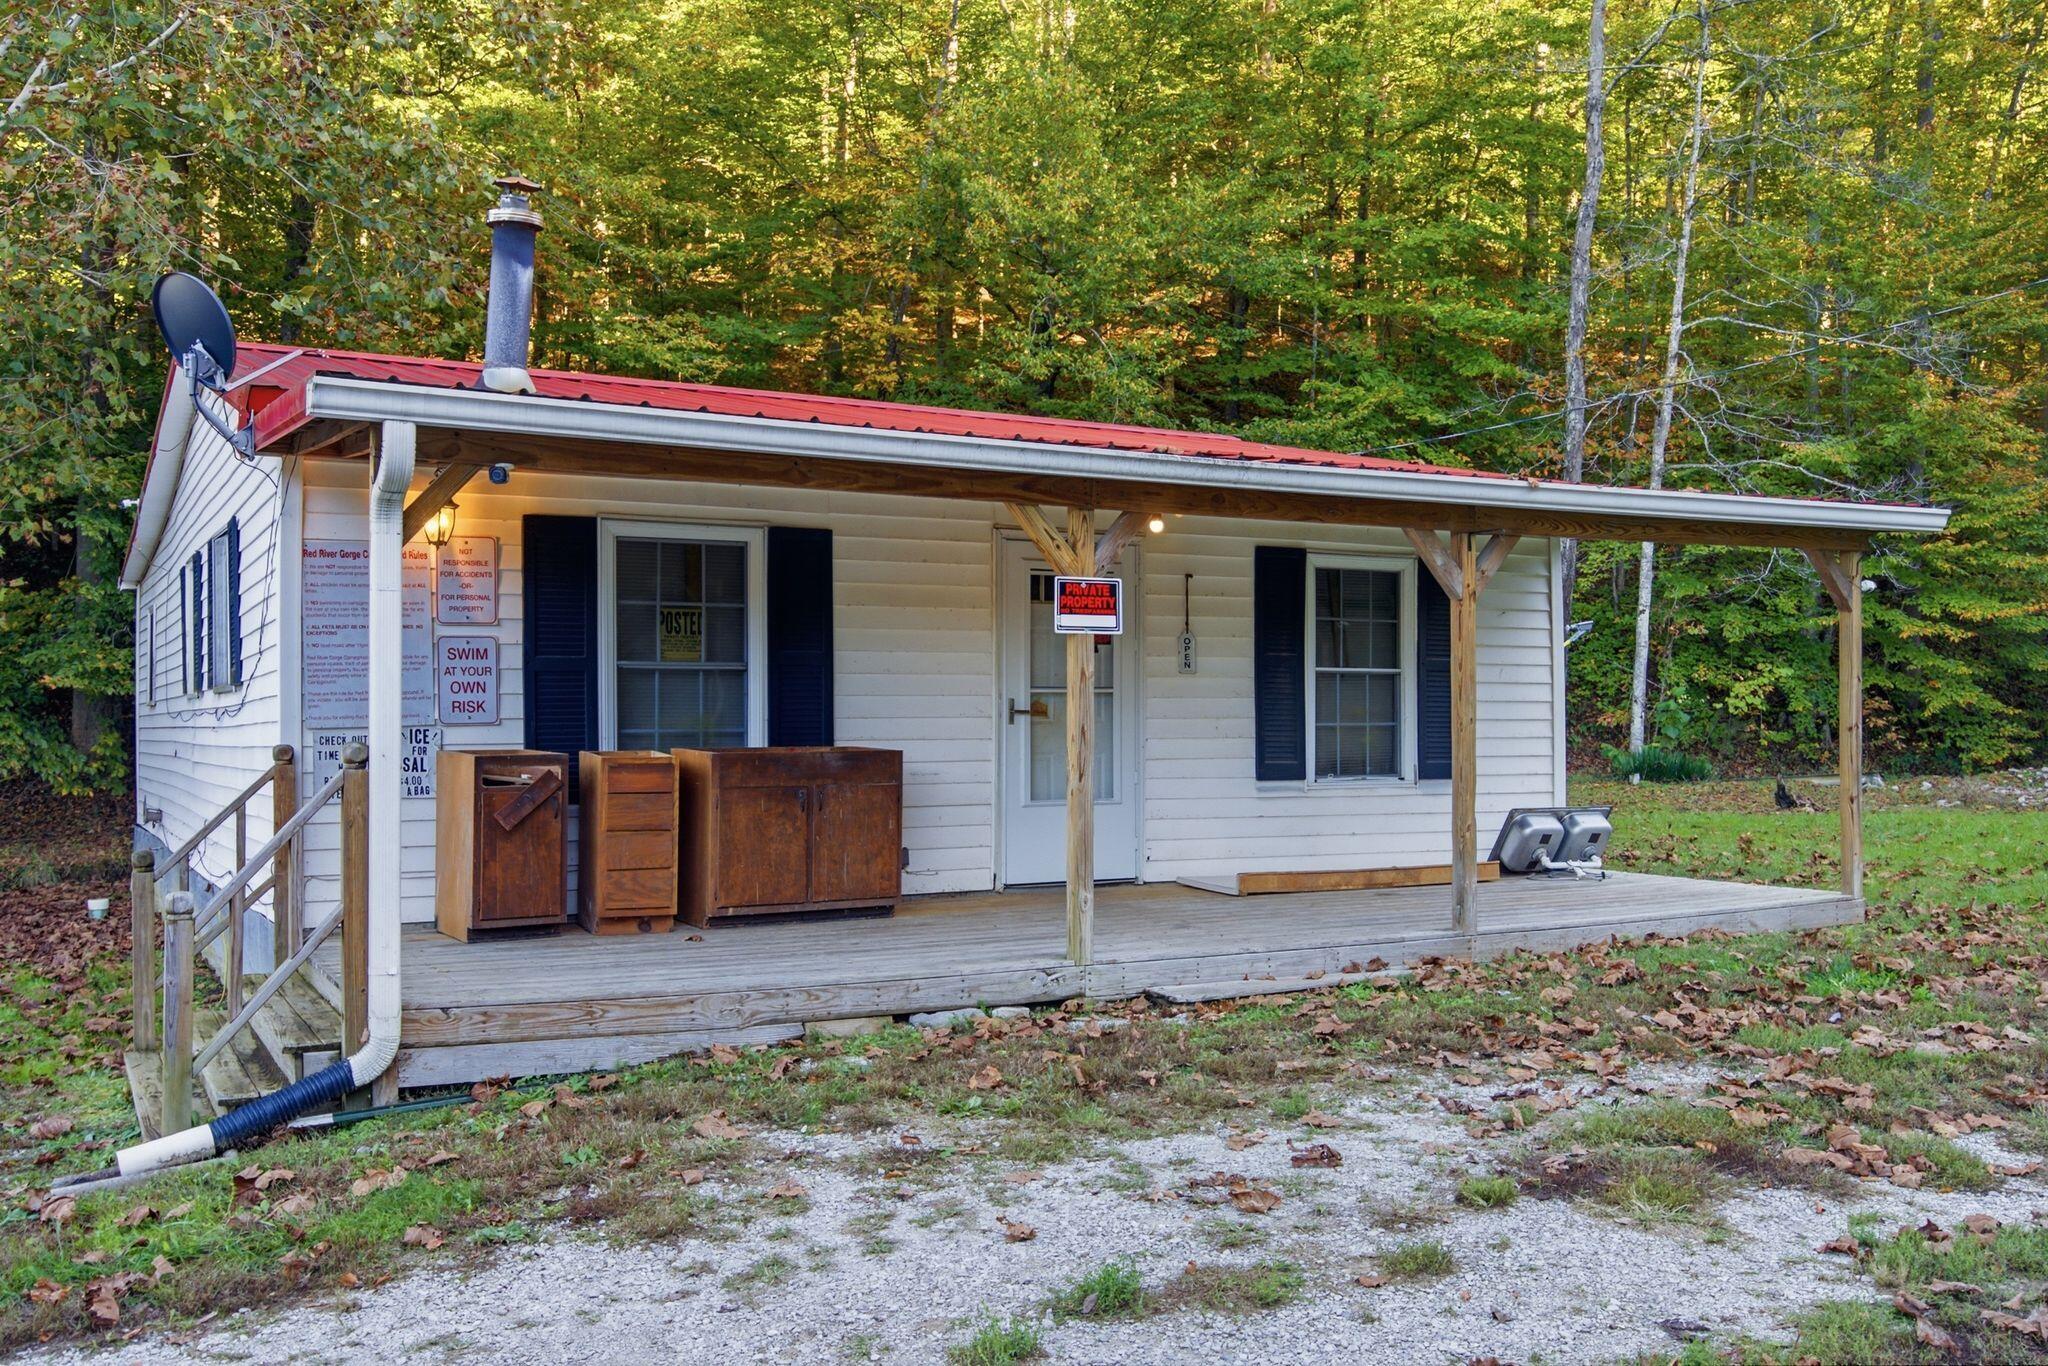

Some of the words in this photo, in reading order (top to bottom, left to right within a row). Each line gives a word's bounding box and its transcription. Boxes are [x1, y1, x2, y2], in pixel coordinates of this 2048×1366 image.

[302, 549, 317, 558] Red
[319, 549, 337, 558] River
[339, 549, 361, 560] Gorge
[408, 550, 428, 560] Rules
[443, 559, 489, 567] RESPONSIBLE
[1065, 583, 1110, 596] PRIVATE
[1060, 595, 1116, 609] PROPERTY
[448, 605, 484, 613] PROPERTY
[447, 647, 488, 661] SWIM
[1183, 637, 1191, 669] OPEN
[443, 666, 457, 676] AT
[460, 666, 493, 676] YOUR
[450, 681, 487, 694] OWN
[451, 700, 486, 713] RISK
[319, 735, 347, 746] CHECK
[409, 728, 430, 744] ICE
[317, 750, 339, 761] TIME
[412, 746, 427, 755] FOR
[402, 757, 427, 772] SAL
[407, 787, 412, 796] A
[414, 786, 430, 796] BAG
